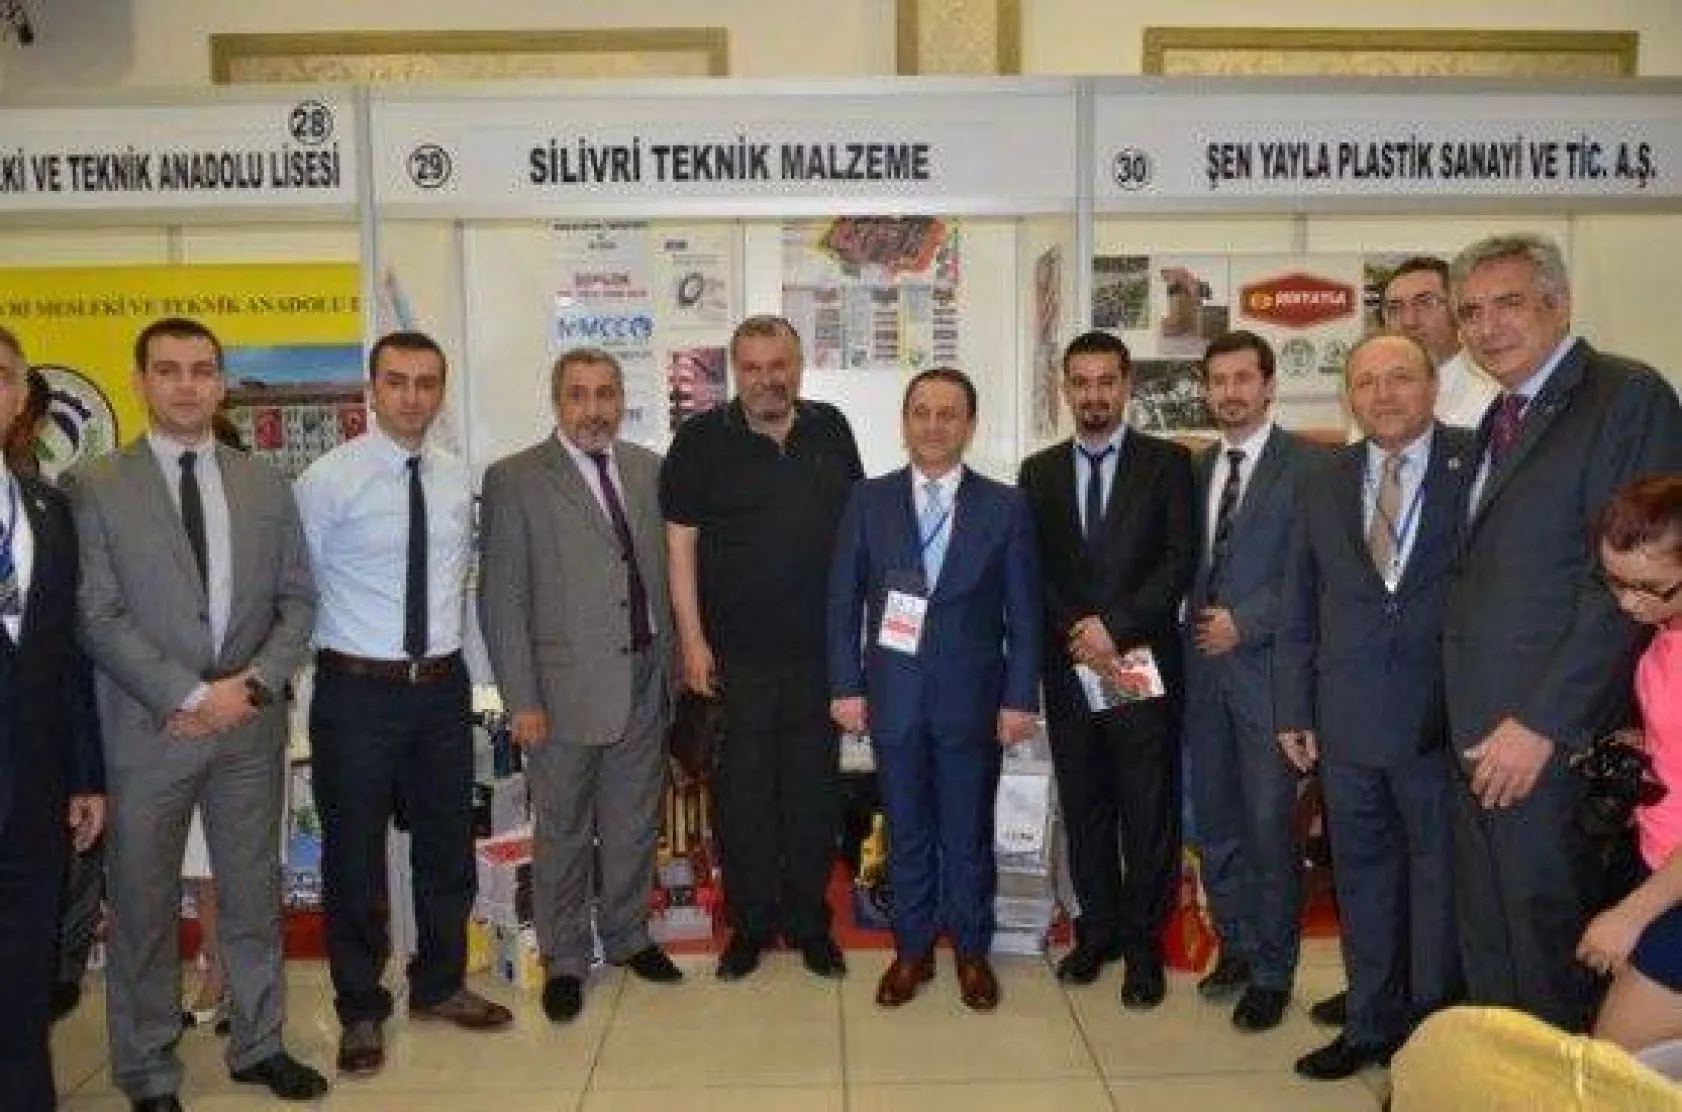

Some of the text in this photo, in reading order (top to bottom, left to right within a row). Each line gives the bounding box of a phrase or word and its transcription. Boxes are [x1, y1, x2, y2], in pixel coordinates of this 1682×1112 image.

[292, 108, 325, 137] 28
[0, 142, 340, 192] Kİ VE TEKNİK ANADOLU LİSESİ
[414, 151, 444, 180] 29
[529, 136, 930, 184] SİLİVRİ TEKNİK MALZEME
[1118, 155, 1147, 183] 30
[1206, 133, 1657, 191] ŞEN YAYLA PLASTİK SANAYİ VE TİC. A.Ş.
